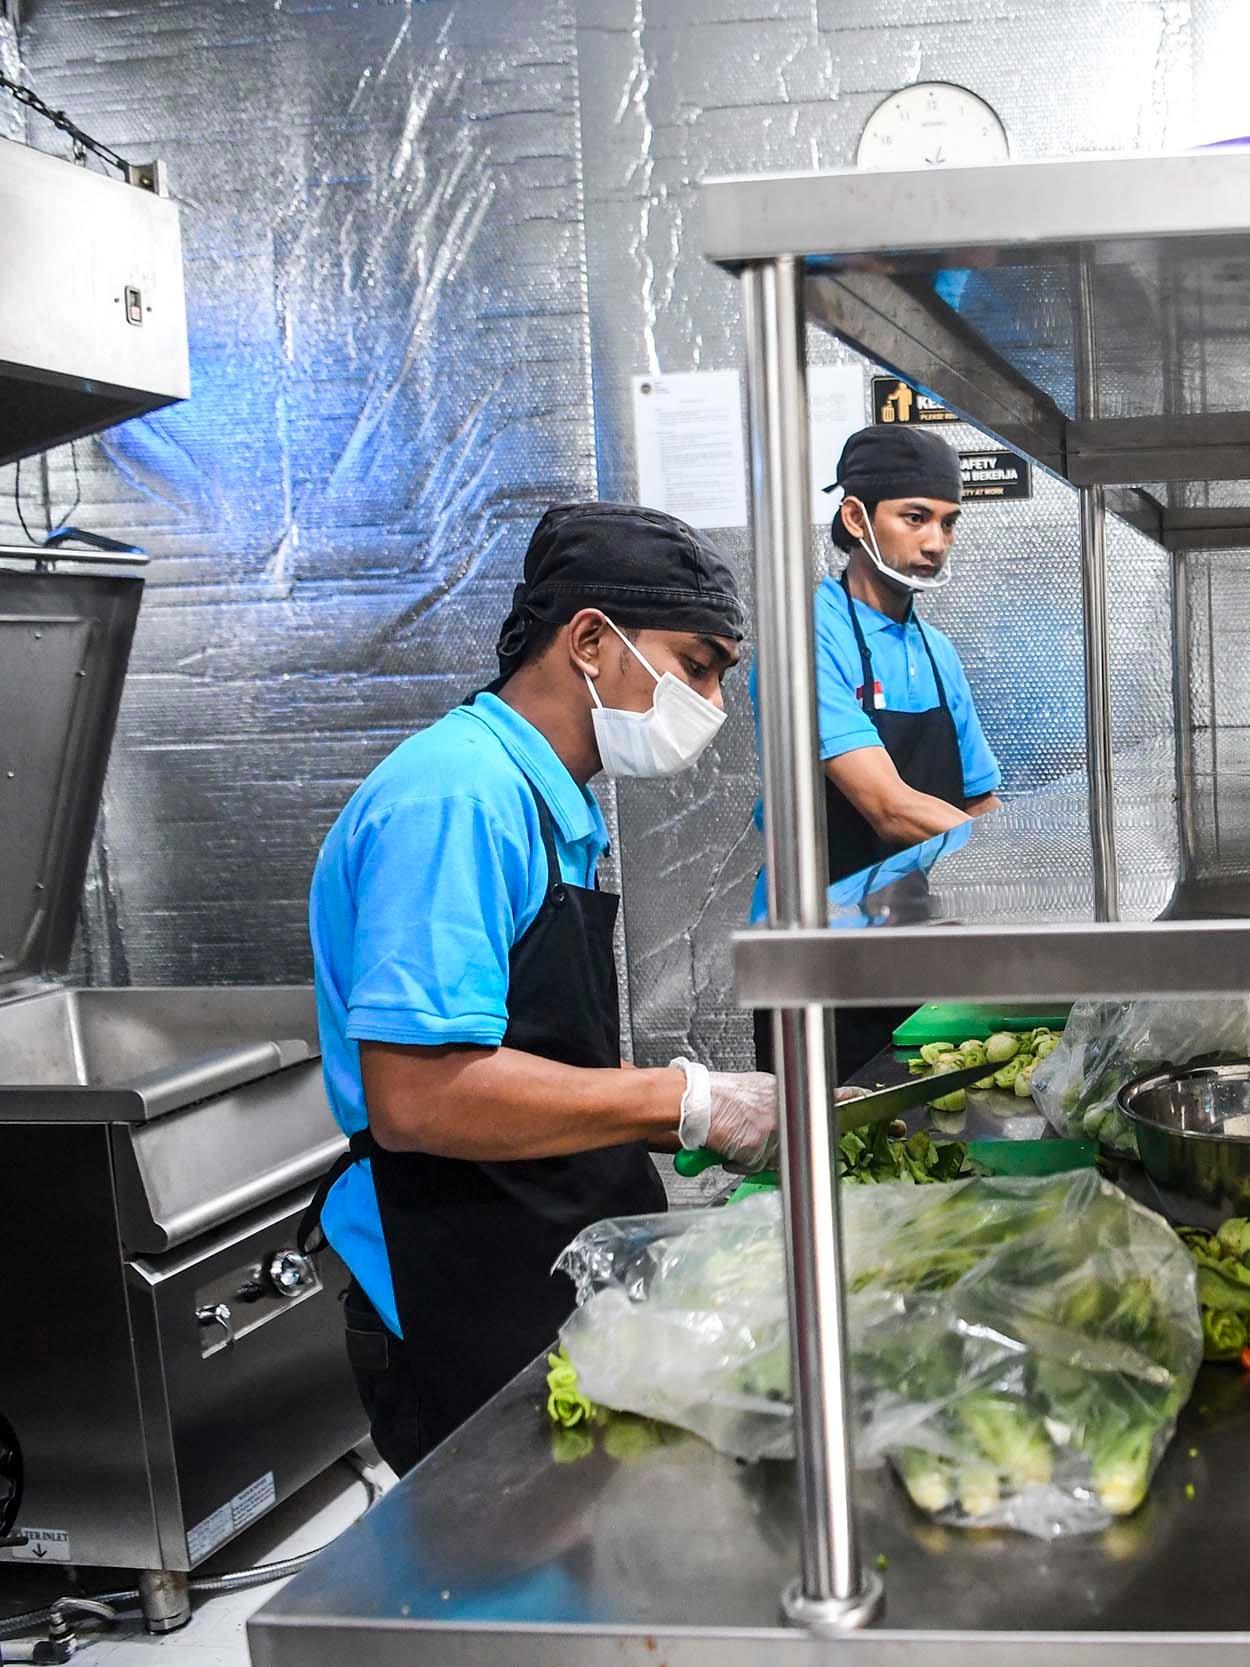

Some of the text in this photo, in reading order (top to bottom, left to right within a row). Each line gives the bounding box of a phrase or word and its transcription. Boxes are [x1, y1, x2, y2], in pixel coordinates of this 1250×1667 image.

[959, 456, 998, 470] AFETY
[971, 468, 1018, 481] BEKERJA
[24, 1531, 68, 1541] TER INLET
